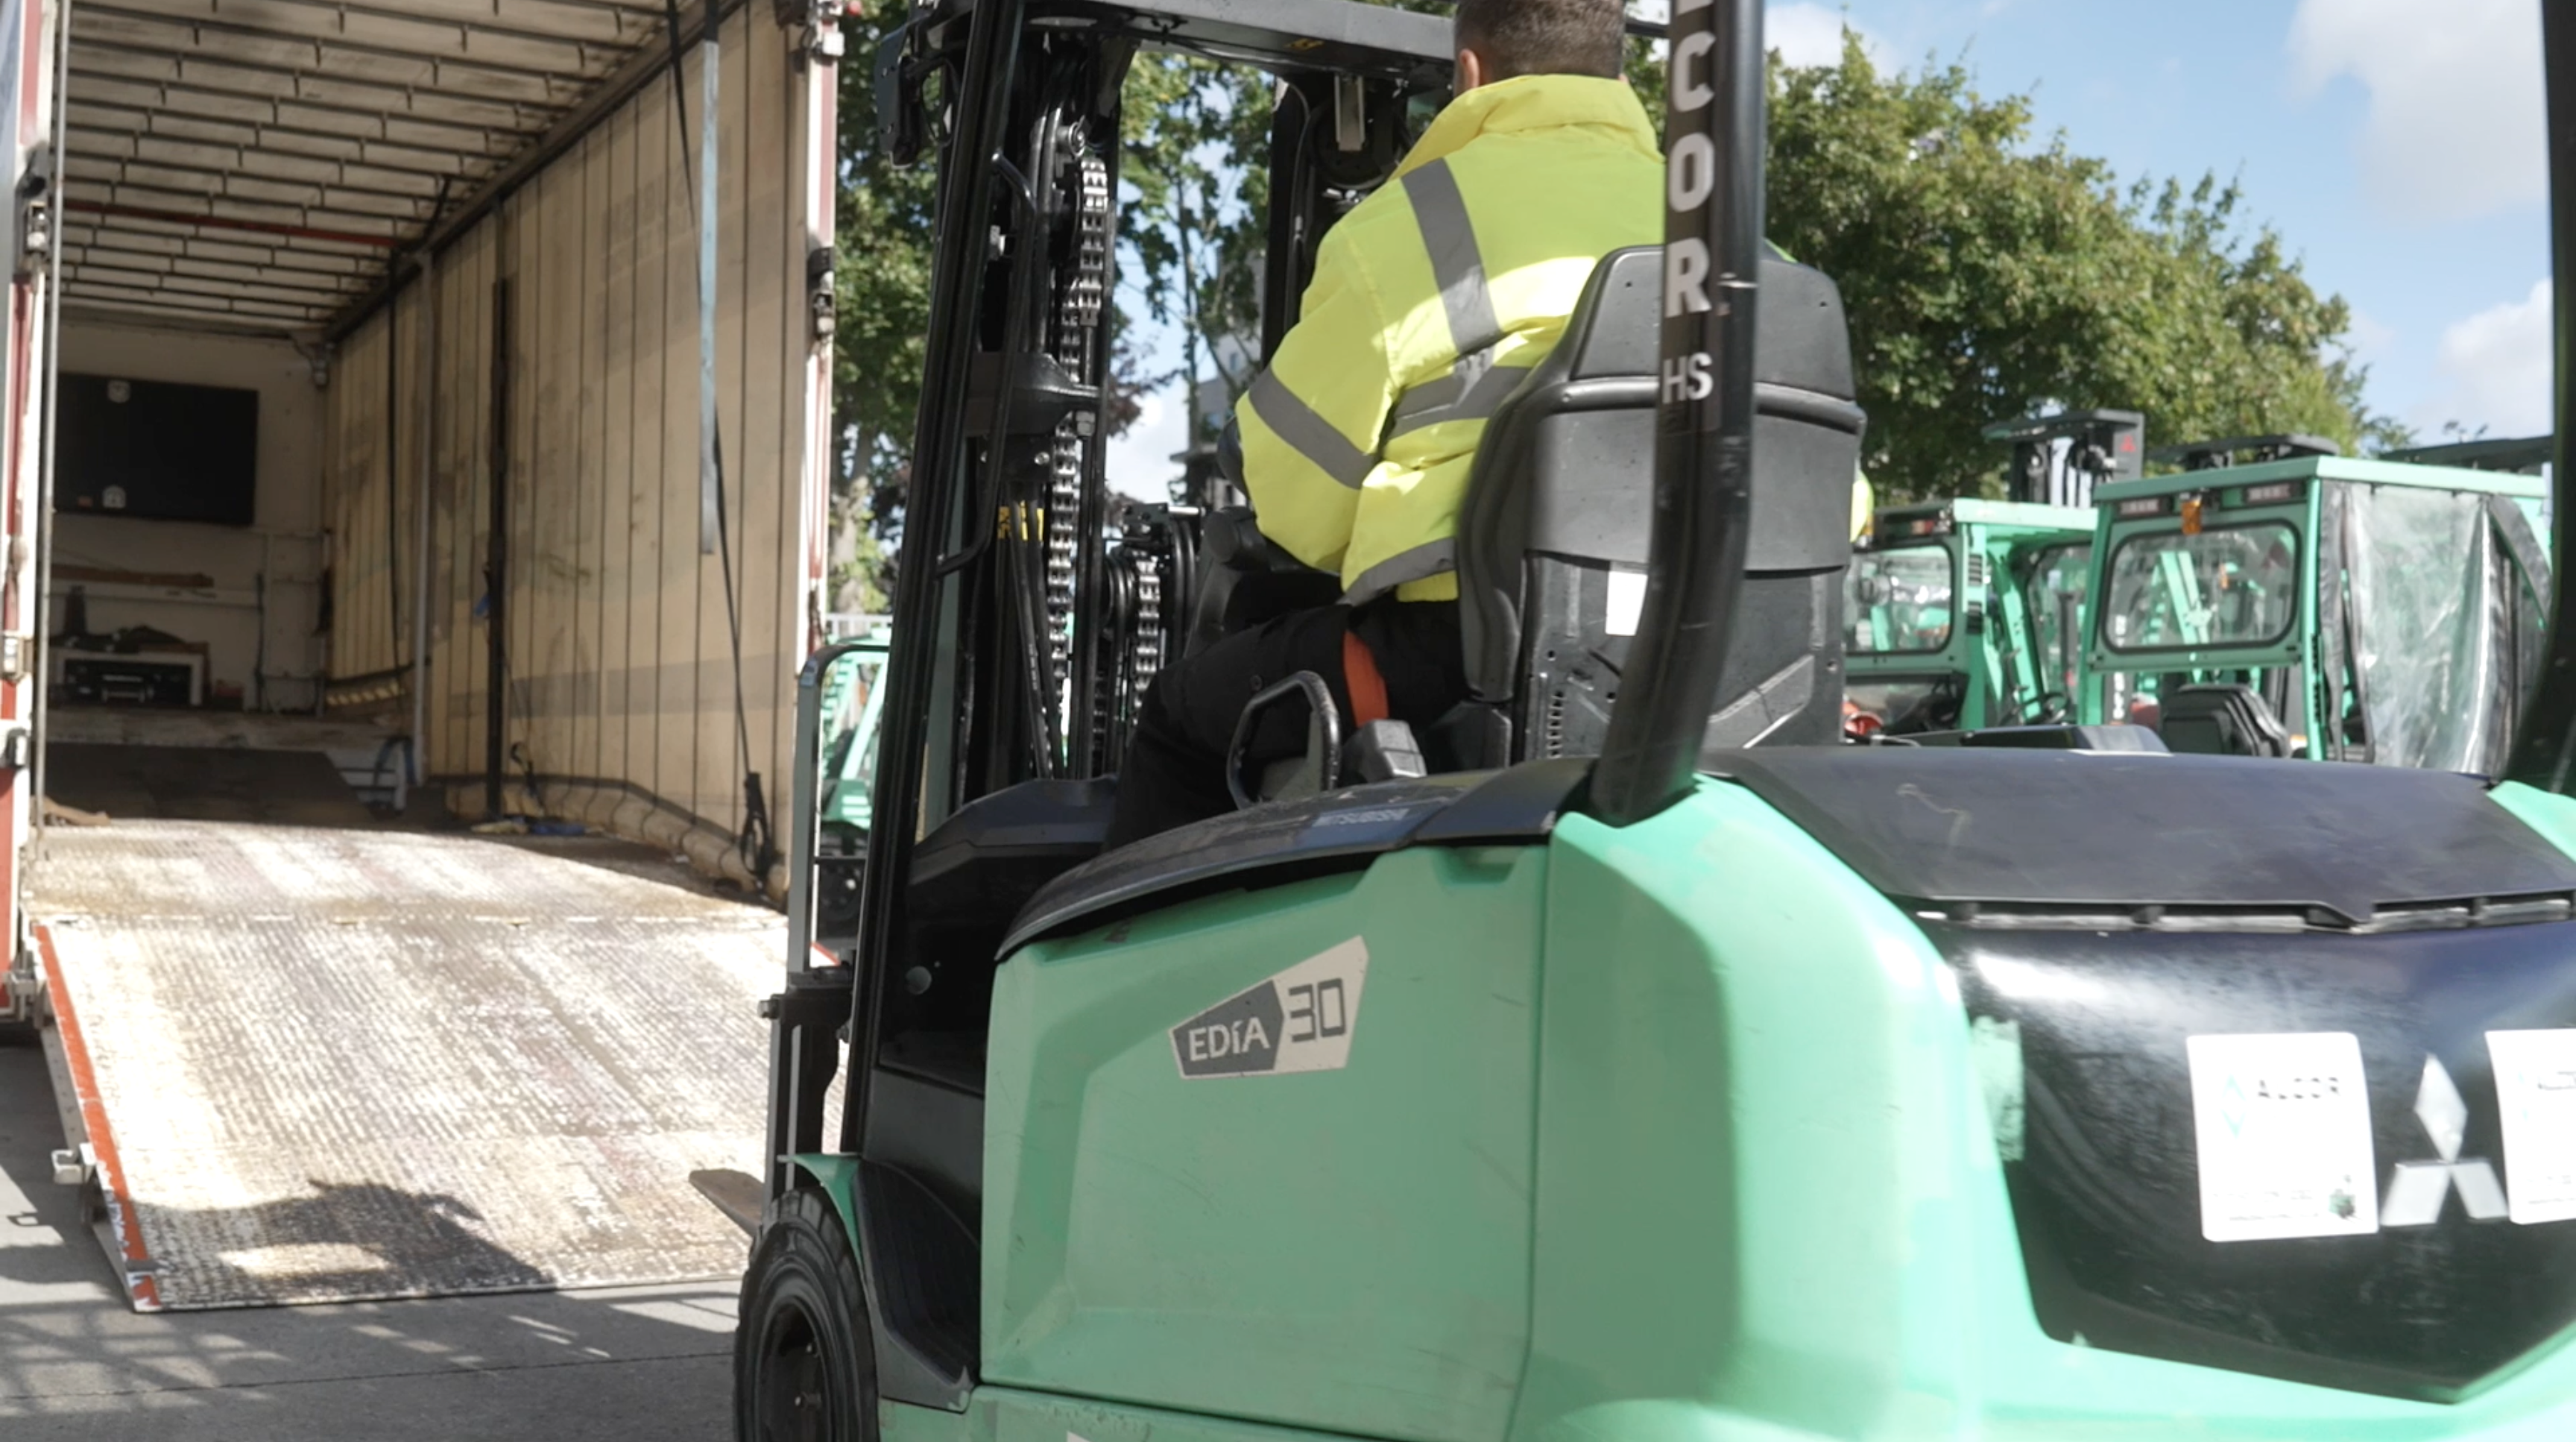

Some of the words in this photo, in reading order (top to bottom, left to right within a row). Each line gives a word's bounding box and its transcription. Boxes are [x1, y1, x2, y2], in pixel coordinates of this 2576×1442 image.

[1665, 0, 1715, 318] COR
[1661, 353, 1713, 404] HS
[1289, 977, 1346, 1042] 30
